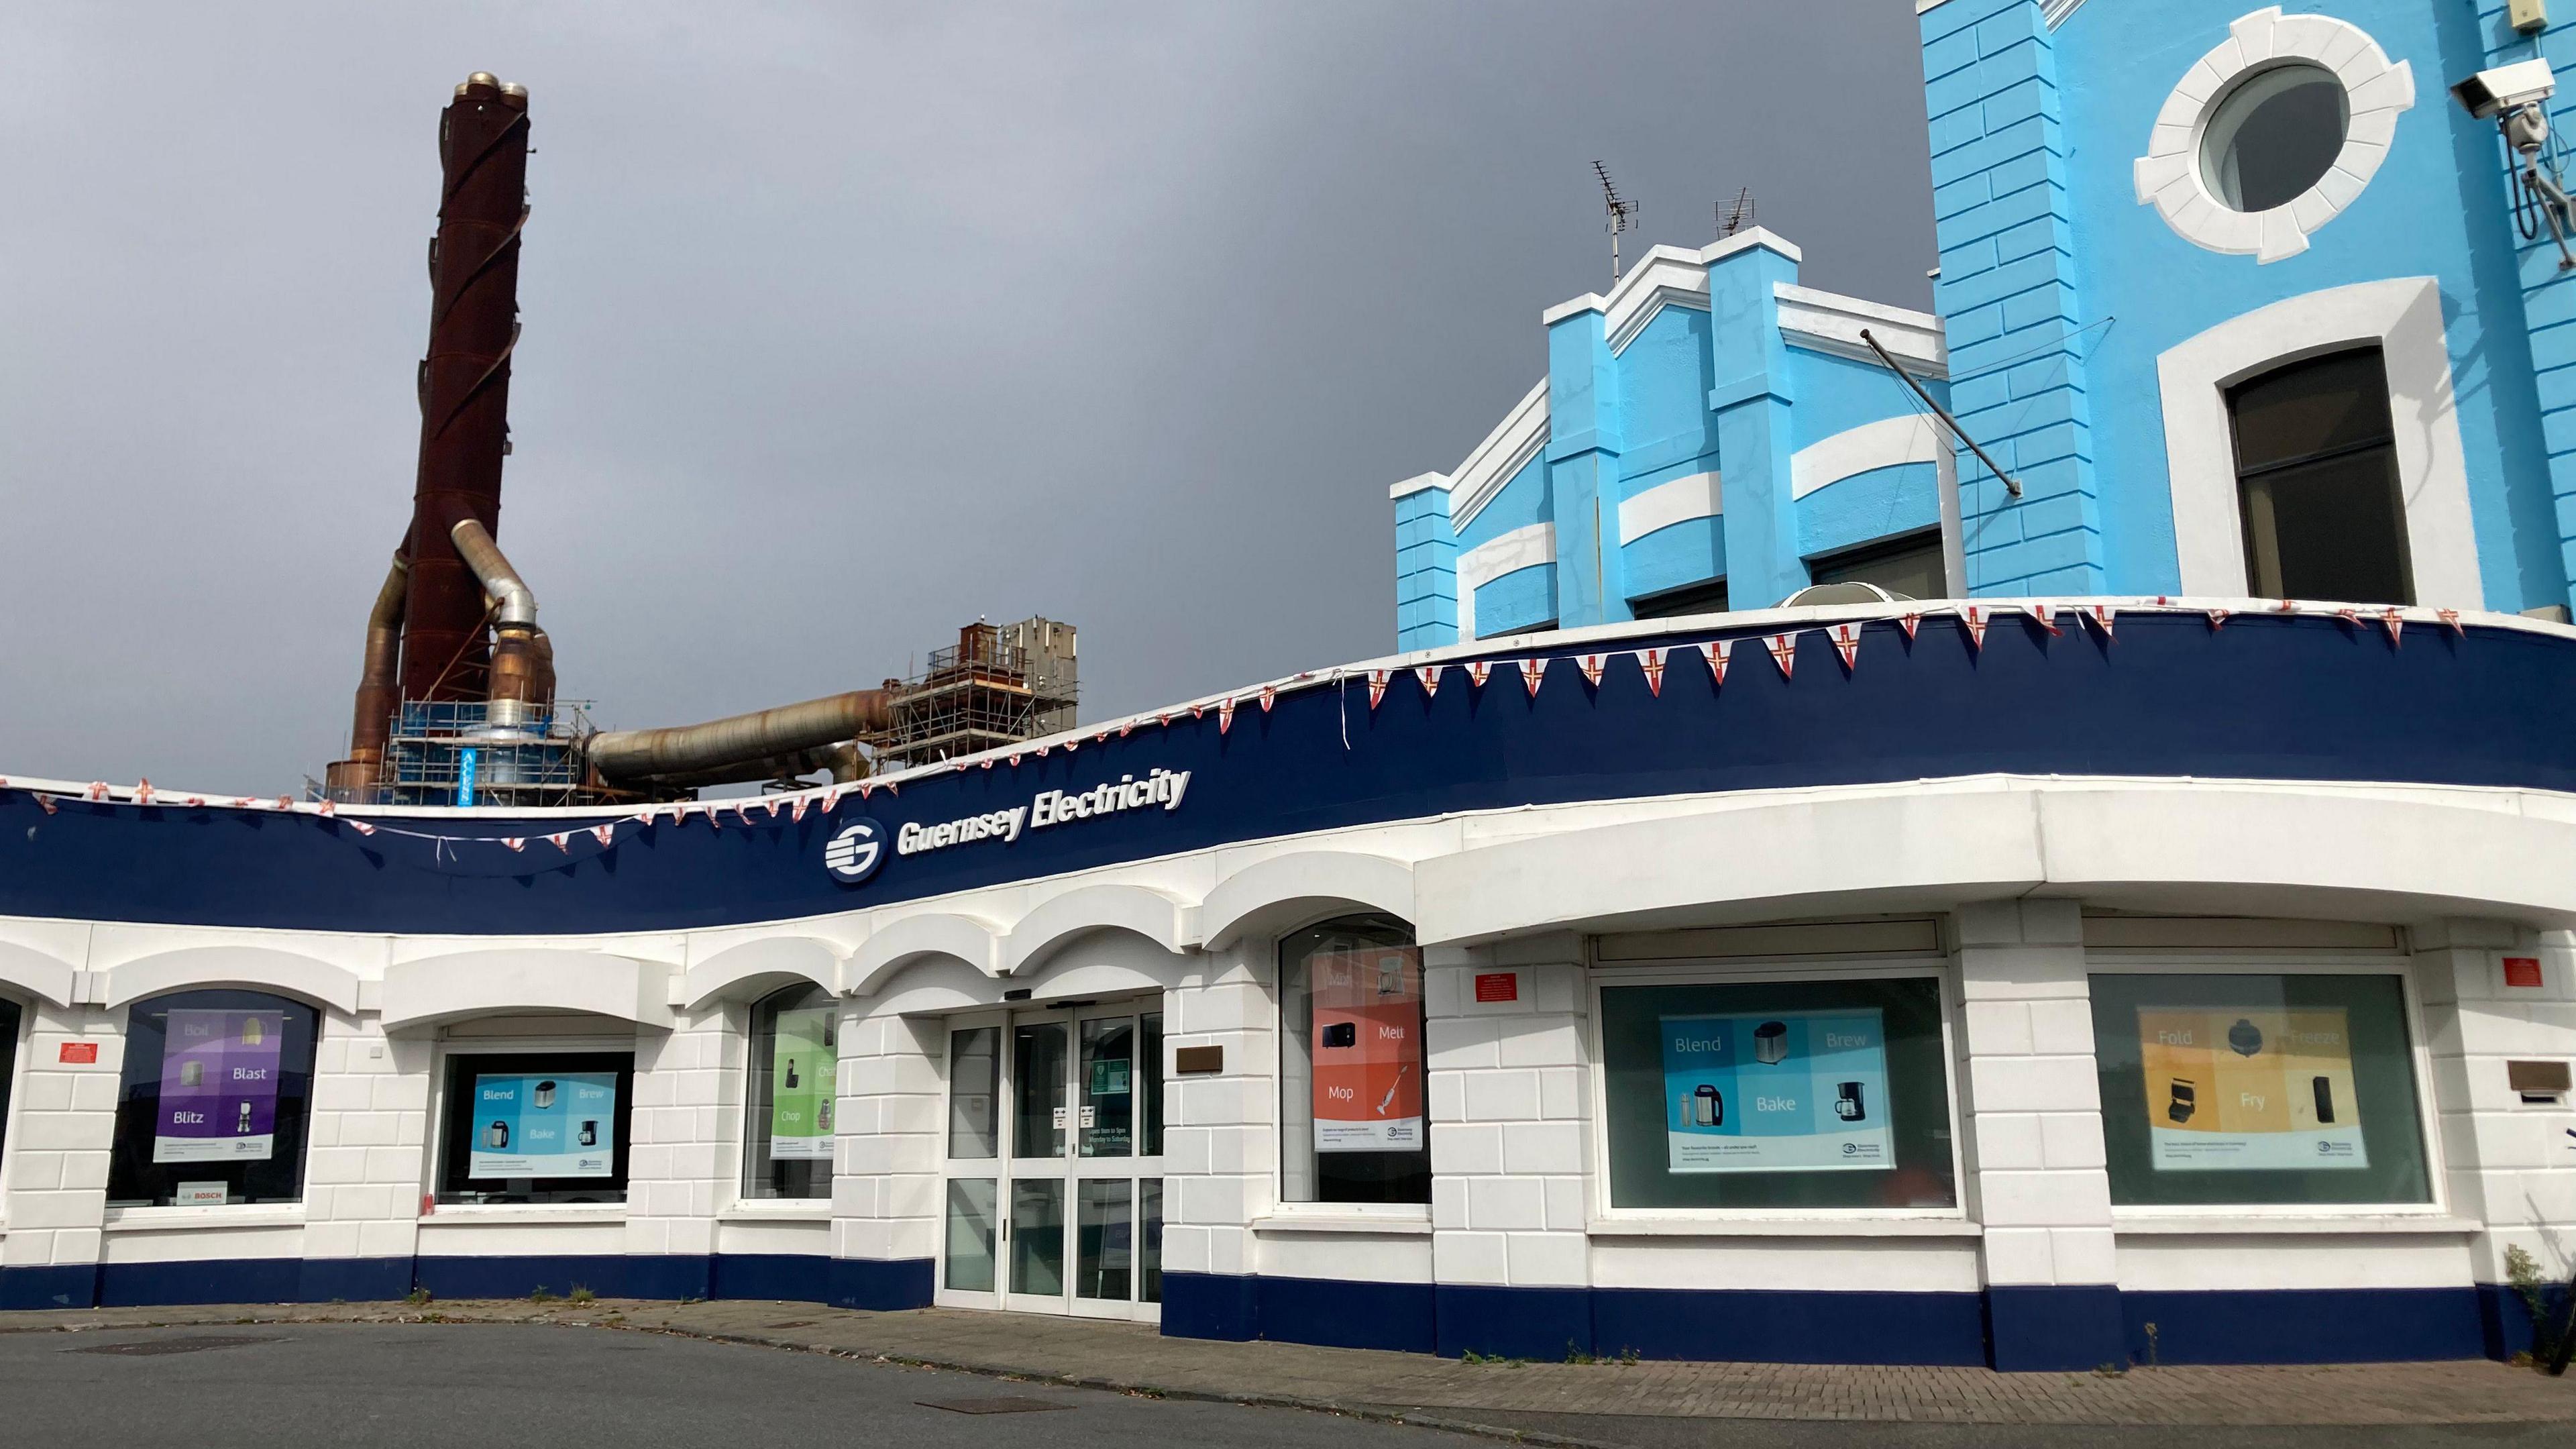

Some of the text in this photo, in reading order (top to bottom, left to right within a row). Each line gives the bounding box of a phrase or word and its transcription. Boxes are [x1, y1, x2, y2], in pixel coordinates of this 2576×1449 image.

[897, 767, 1191, 855] Guernsey Electricity
[184, 1024, 209, 1036] Boil
[1379, 1026, 1405, 1039] Melt
[1675, 1033, 1866, 1053] Blend Brew
[2159, 1030, 2340, 1044] Fold Freeze
[233, 1067, 267, 1079] Blast
[483, 1089, 604, 1100] Blend Brew
[1328, 1086, 1354, 1102] Mop
[1757, 1097, 1796, 1112] Bake
[2241, 1093, 2265, 1110] Fry
[174, 1111, 204, 1124] Blitz
[782, 1111, 800, 1122] Chop
[529, 1129, 555, 1140] Bake
